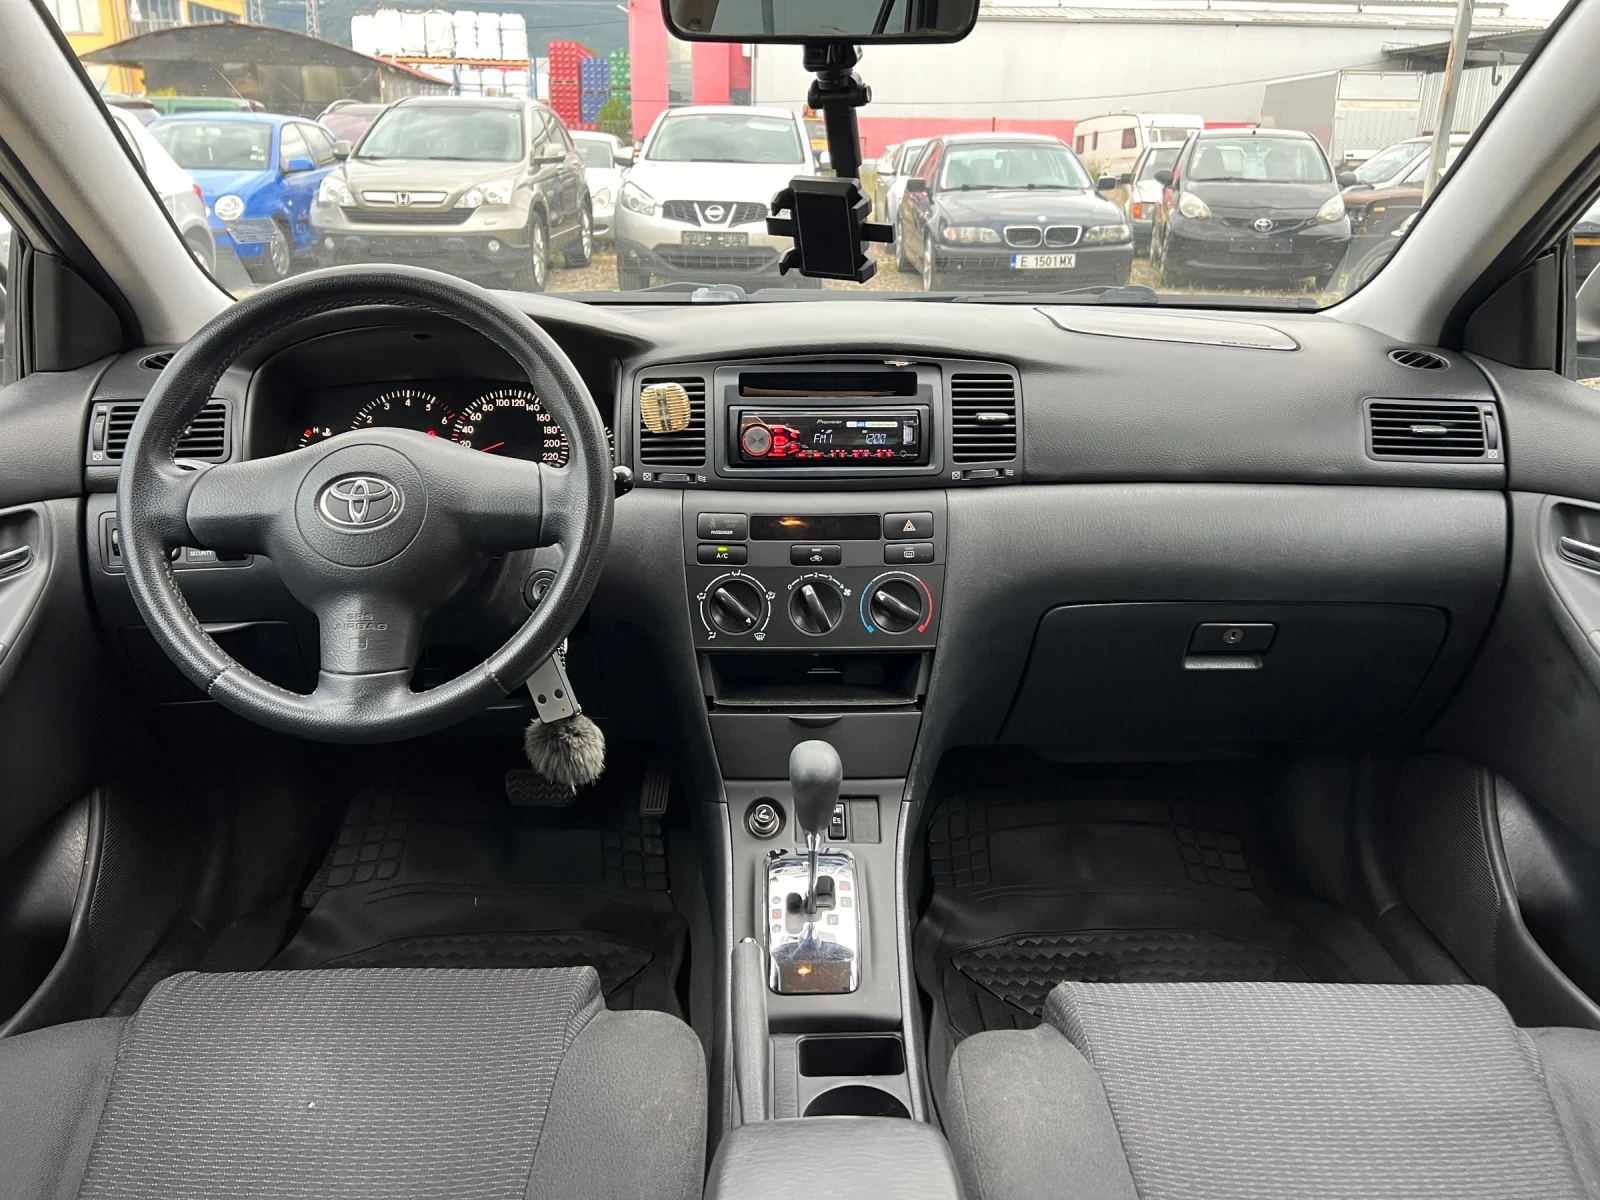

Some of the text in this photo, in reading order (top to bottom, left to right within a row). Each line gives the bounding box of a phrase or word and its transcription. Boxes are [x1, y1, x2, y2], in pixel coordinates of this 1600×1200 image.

[1020, 256, 1028, 267] E
[384, 403, 390, 411] 3
[405, 399, 411, 407] 4
[496, 399, 510, 407] 100
[511, 399, 525, 407] 120
[425, 404, 431, 412] 5
[482, 404, 494, 412] 80
[366, 415, 373, 424] 2
[470, 412, 482, 421] 60
[462, 426, 474, 434] 40
[543, 426, 558, 434] 180
[543, 439, 560, 447] 200
[334, 622, 388, 631] AIRBAG
